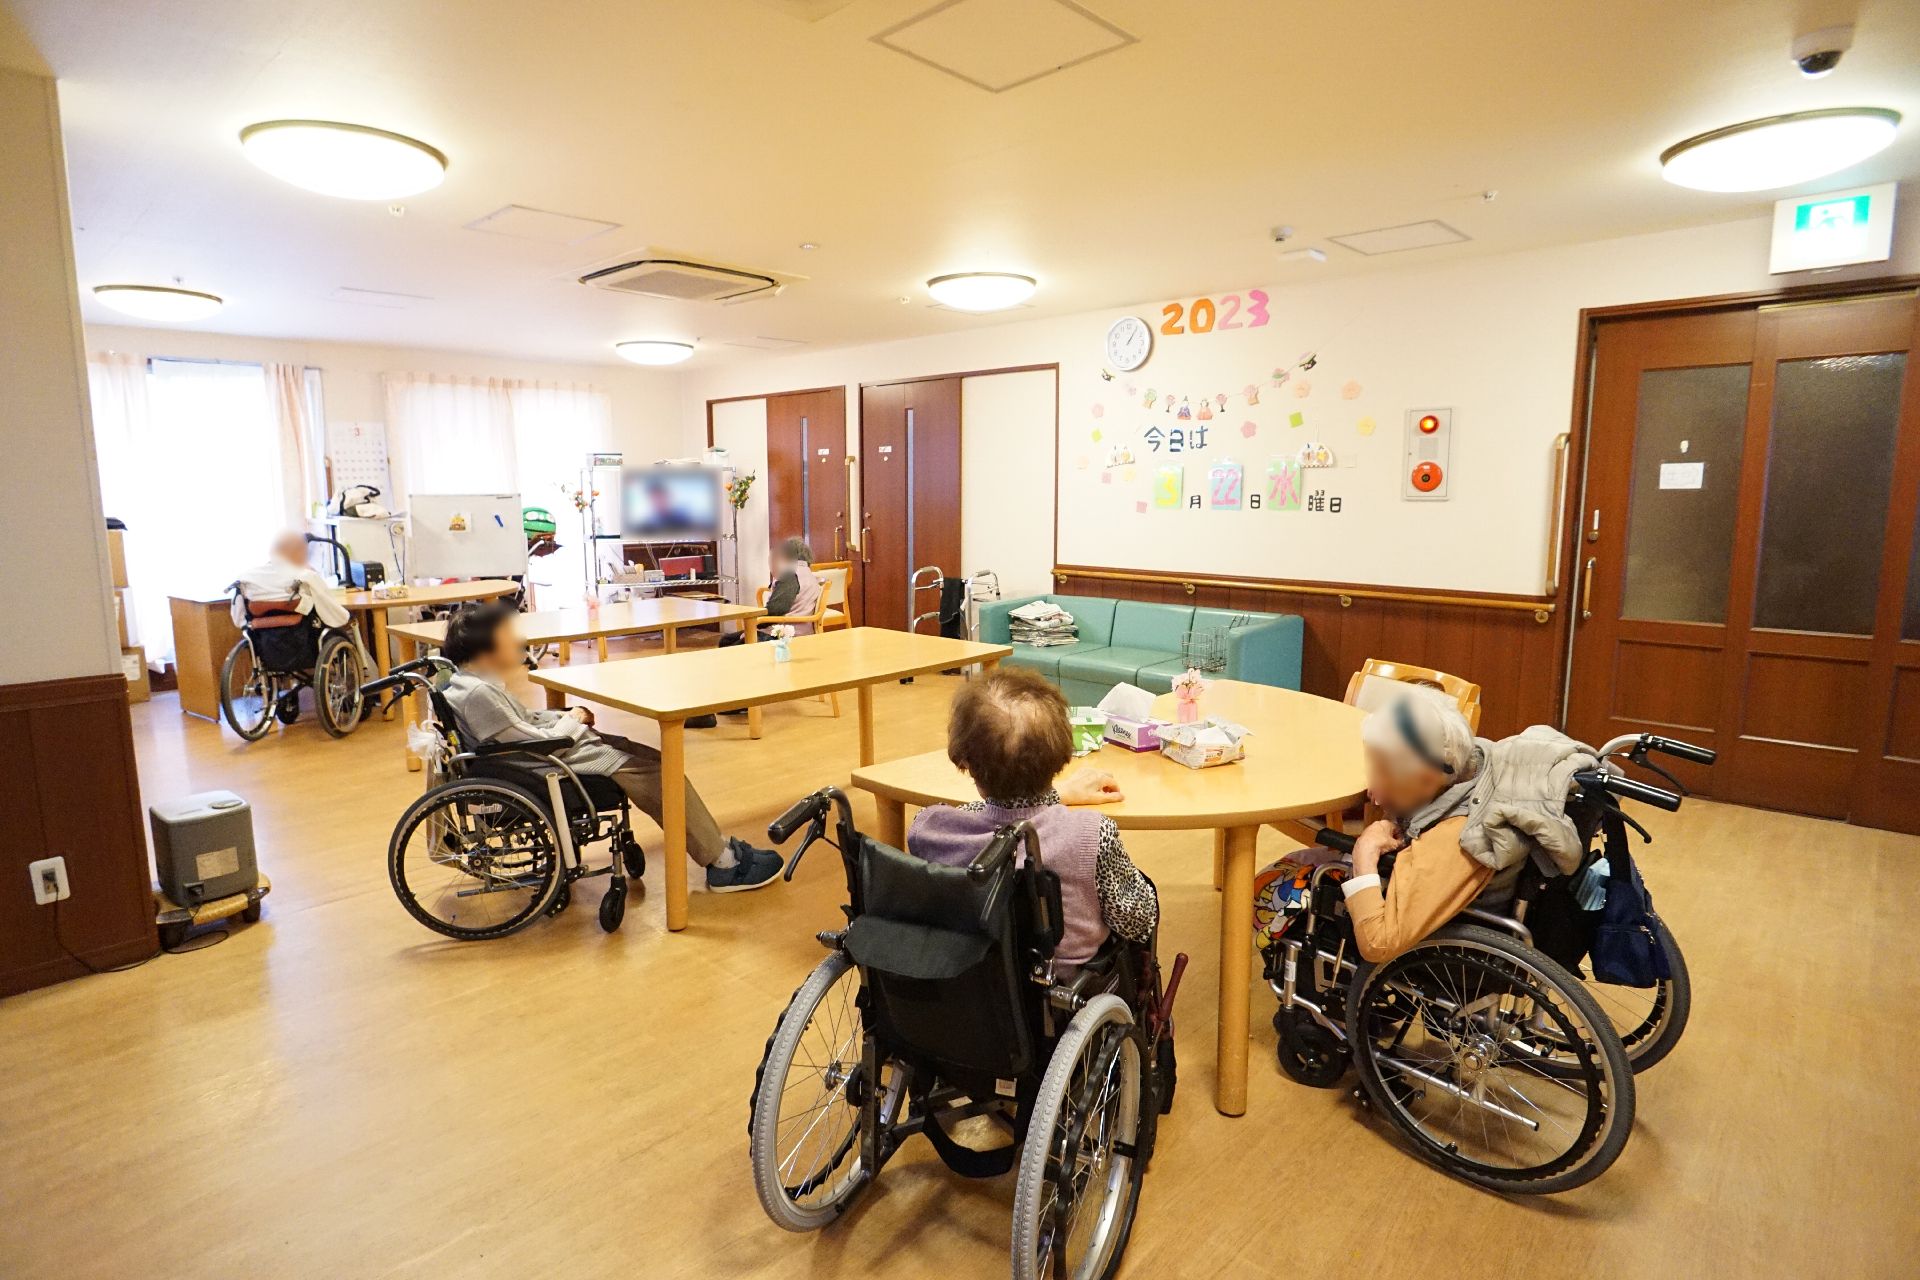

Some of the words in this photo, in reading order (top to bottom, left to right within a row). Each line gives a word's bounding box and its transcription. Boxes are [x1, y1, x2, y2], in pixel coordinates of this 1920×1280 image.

[1160, 289, 1270, 335] 2023
[1144, 425, 1208, 452] 今日は
